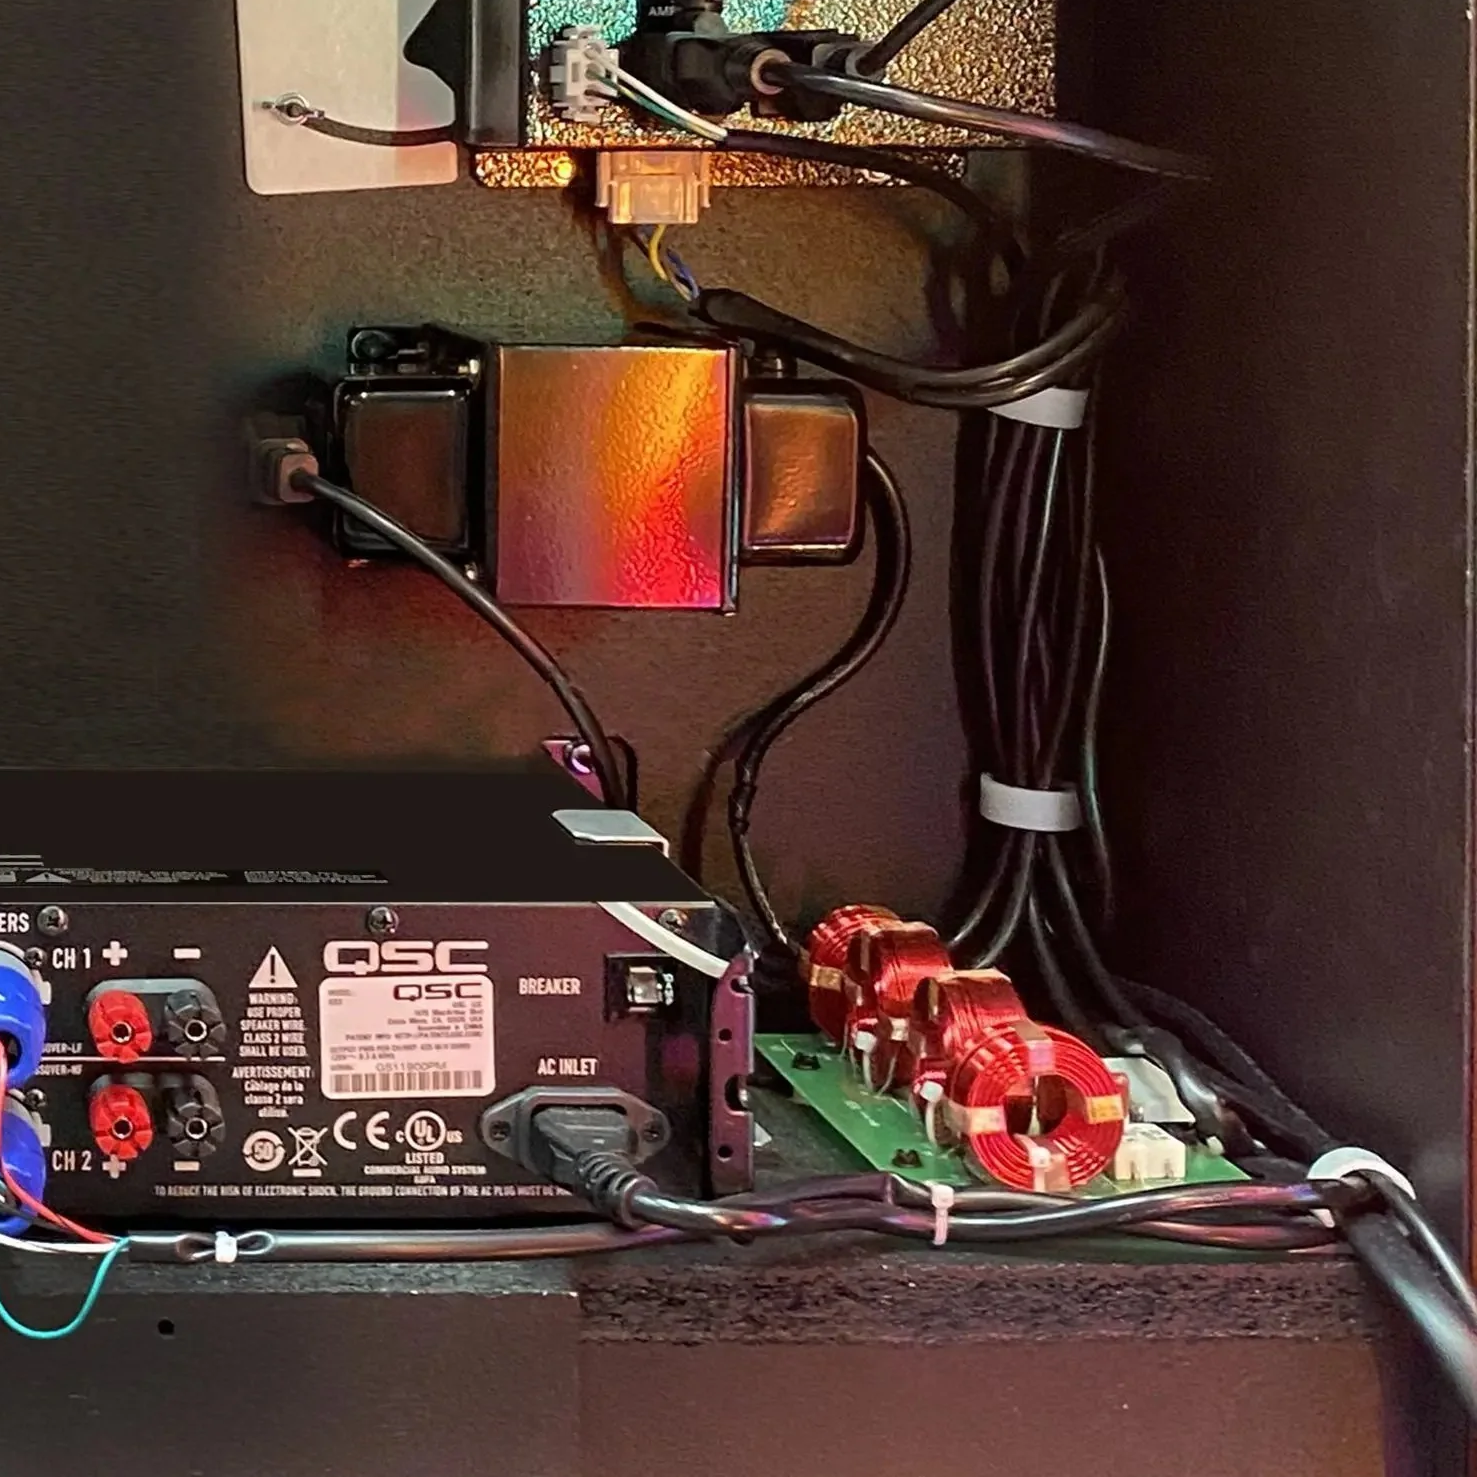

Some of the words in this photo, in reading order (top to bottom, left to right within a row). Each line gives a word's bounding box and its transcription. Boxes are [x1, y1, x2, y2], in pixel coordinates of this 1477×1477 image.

[52, 949, 75, 968] CH
[82, 949, 91, 968] 1
[324, 940, 489, 975] QSC
[393, 983, 483, 1002] QSC
[519, 977, 581, 995] BREAKER
[240, 1019, 281, 1031] SPEAKER
[244, 1032, 272, 1044] CLASS
[273, 1032, 280, 1044] 2
[239, 1045, 267, 1057] SHALL
[537, 1058, 556, 1075] AC
[559, 1058, 598, 1075] INLET
[52, 1150, 76, 1171] CH
[81, 1150, 93, 1171] 2
[405, 1152, 444, 1165] LISTED
[155, 1185, 166, 1197] TO
[202, 1185, 218, 1197] THE
[255, 1185, 307, 1197] ELECTRONIC
[340, 1185, 357, 1197] THE
[394, 1185, 449, 1197] CONNECTION
[463, 1185, 479, 1197] THE
[494, 1185, 516, 1197] PLUG
